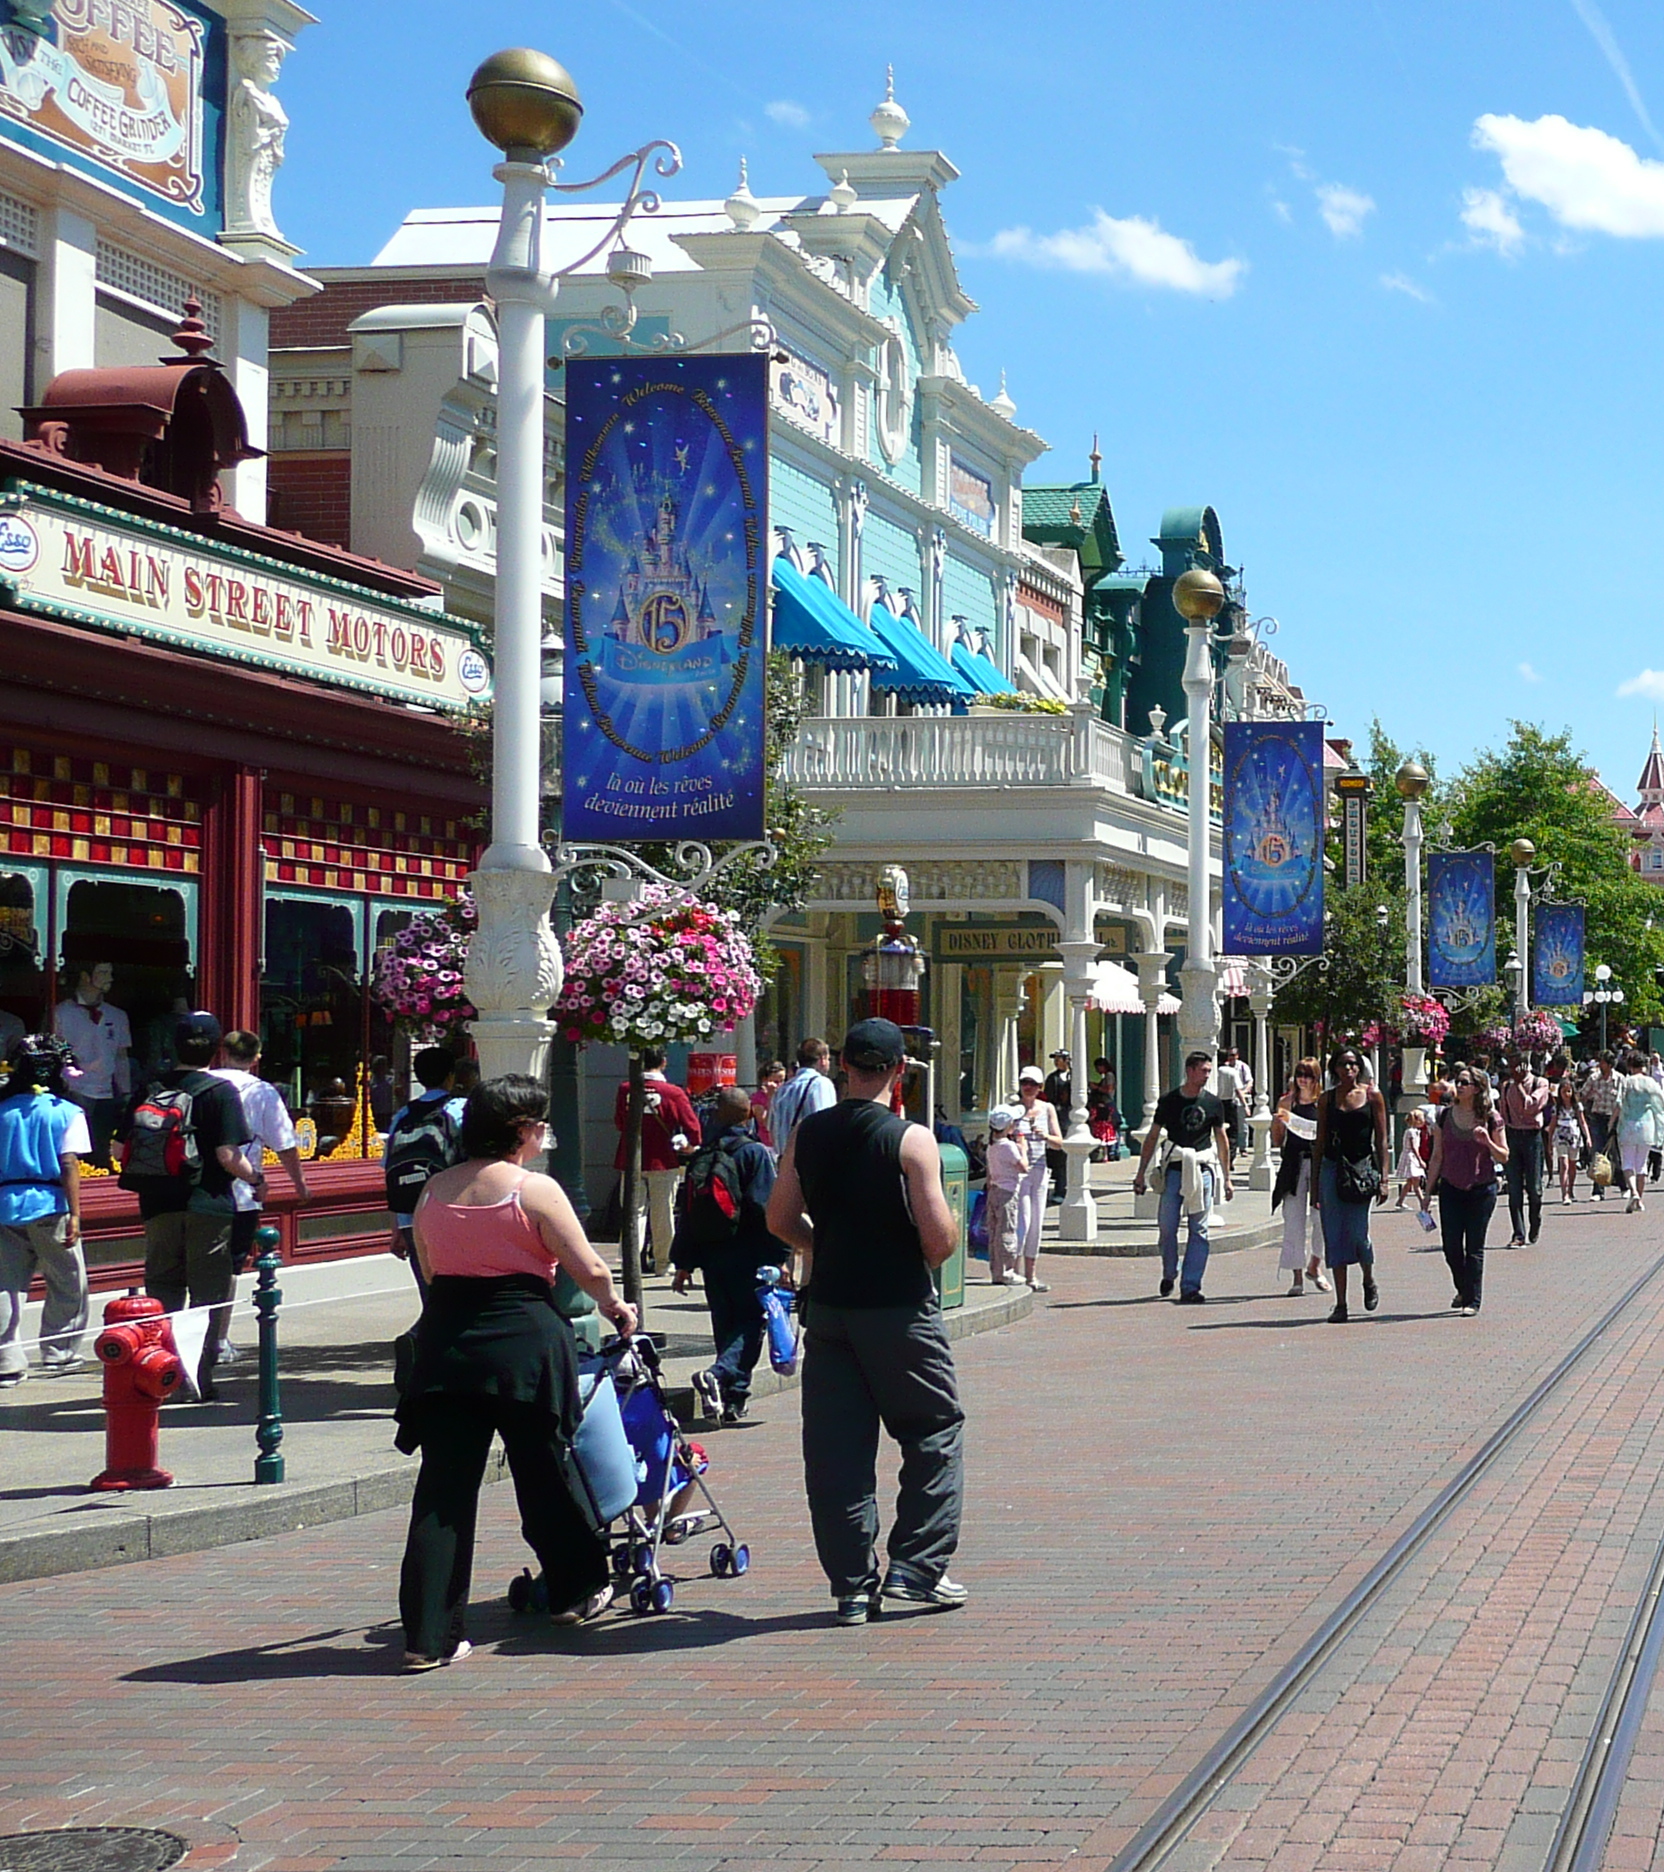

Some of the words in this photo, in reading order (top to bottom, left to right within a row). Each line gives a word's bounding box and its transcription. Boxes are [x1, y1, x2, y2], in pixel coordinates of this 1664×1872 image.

[67, 76, 117, 131] COFFEE
[119, 110, 171, 141] GRINDER
[621, 381, 685, 408] Welcome
[61, 531, 168, 597] MAIN
[184, 566, 312, 636] STREET
[326, 608, 444, 673] MOTORS
[642, 595, 686, 653] 15
[462, 655, 483, 679] Esso
[605, 771, 622, 791] là
[625, 773, 645, 794] où
[649, 776, 670, 796] les
[674, 774, 714, 794] rêves
[584, 792, 678, 820] deviennent
[683, 788, 735, 818] réalité
[949, 931, 1000, 950] DISNEY
